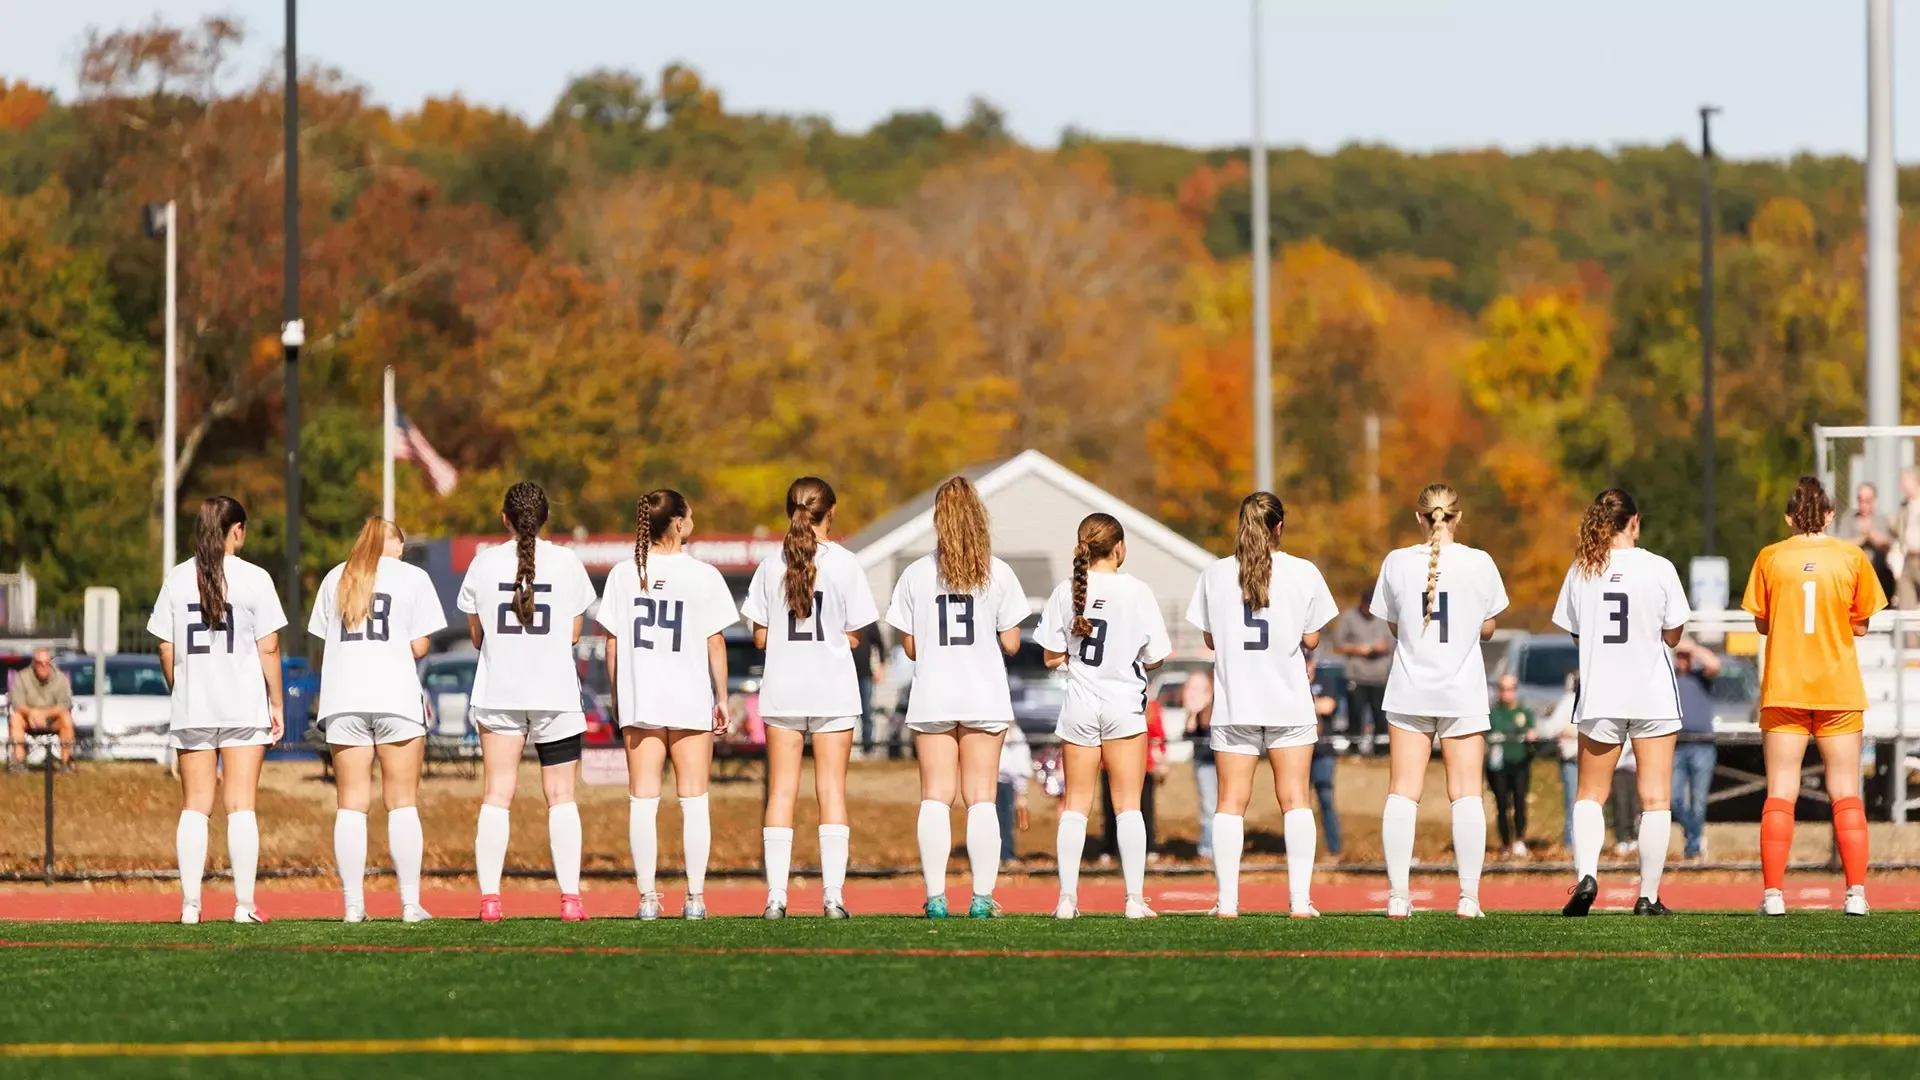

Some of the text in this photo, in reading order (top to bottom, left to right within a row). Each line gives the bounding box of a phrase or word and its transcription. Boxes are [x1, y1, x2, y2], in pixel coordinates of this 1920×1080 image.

[652, 580, 666, 590] E
[1610, 573, 1623, 583] E
[633, 597, 684, 652] 24
[935, 594, 974, 646] 13
[1092, 599, 1106, 609] E
[1243, 599, 1270, 650] 5
[1421, 591, 1448, 643] 4
[1603, 592, 1629, 644] 3
[1802, 581, 1816, 634] 1
[1079, 618, 1108, 667] 8
